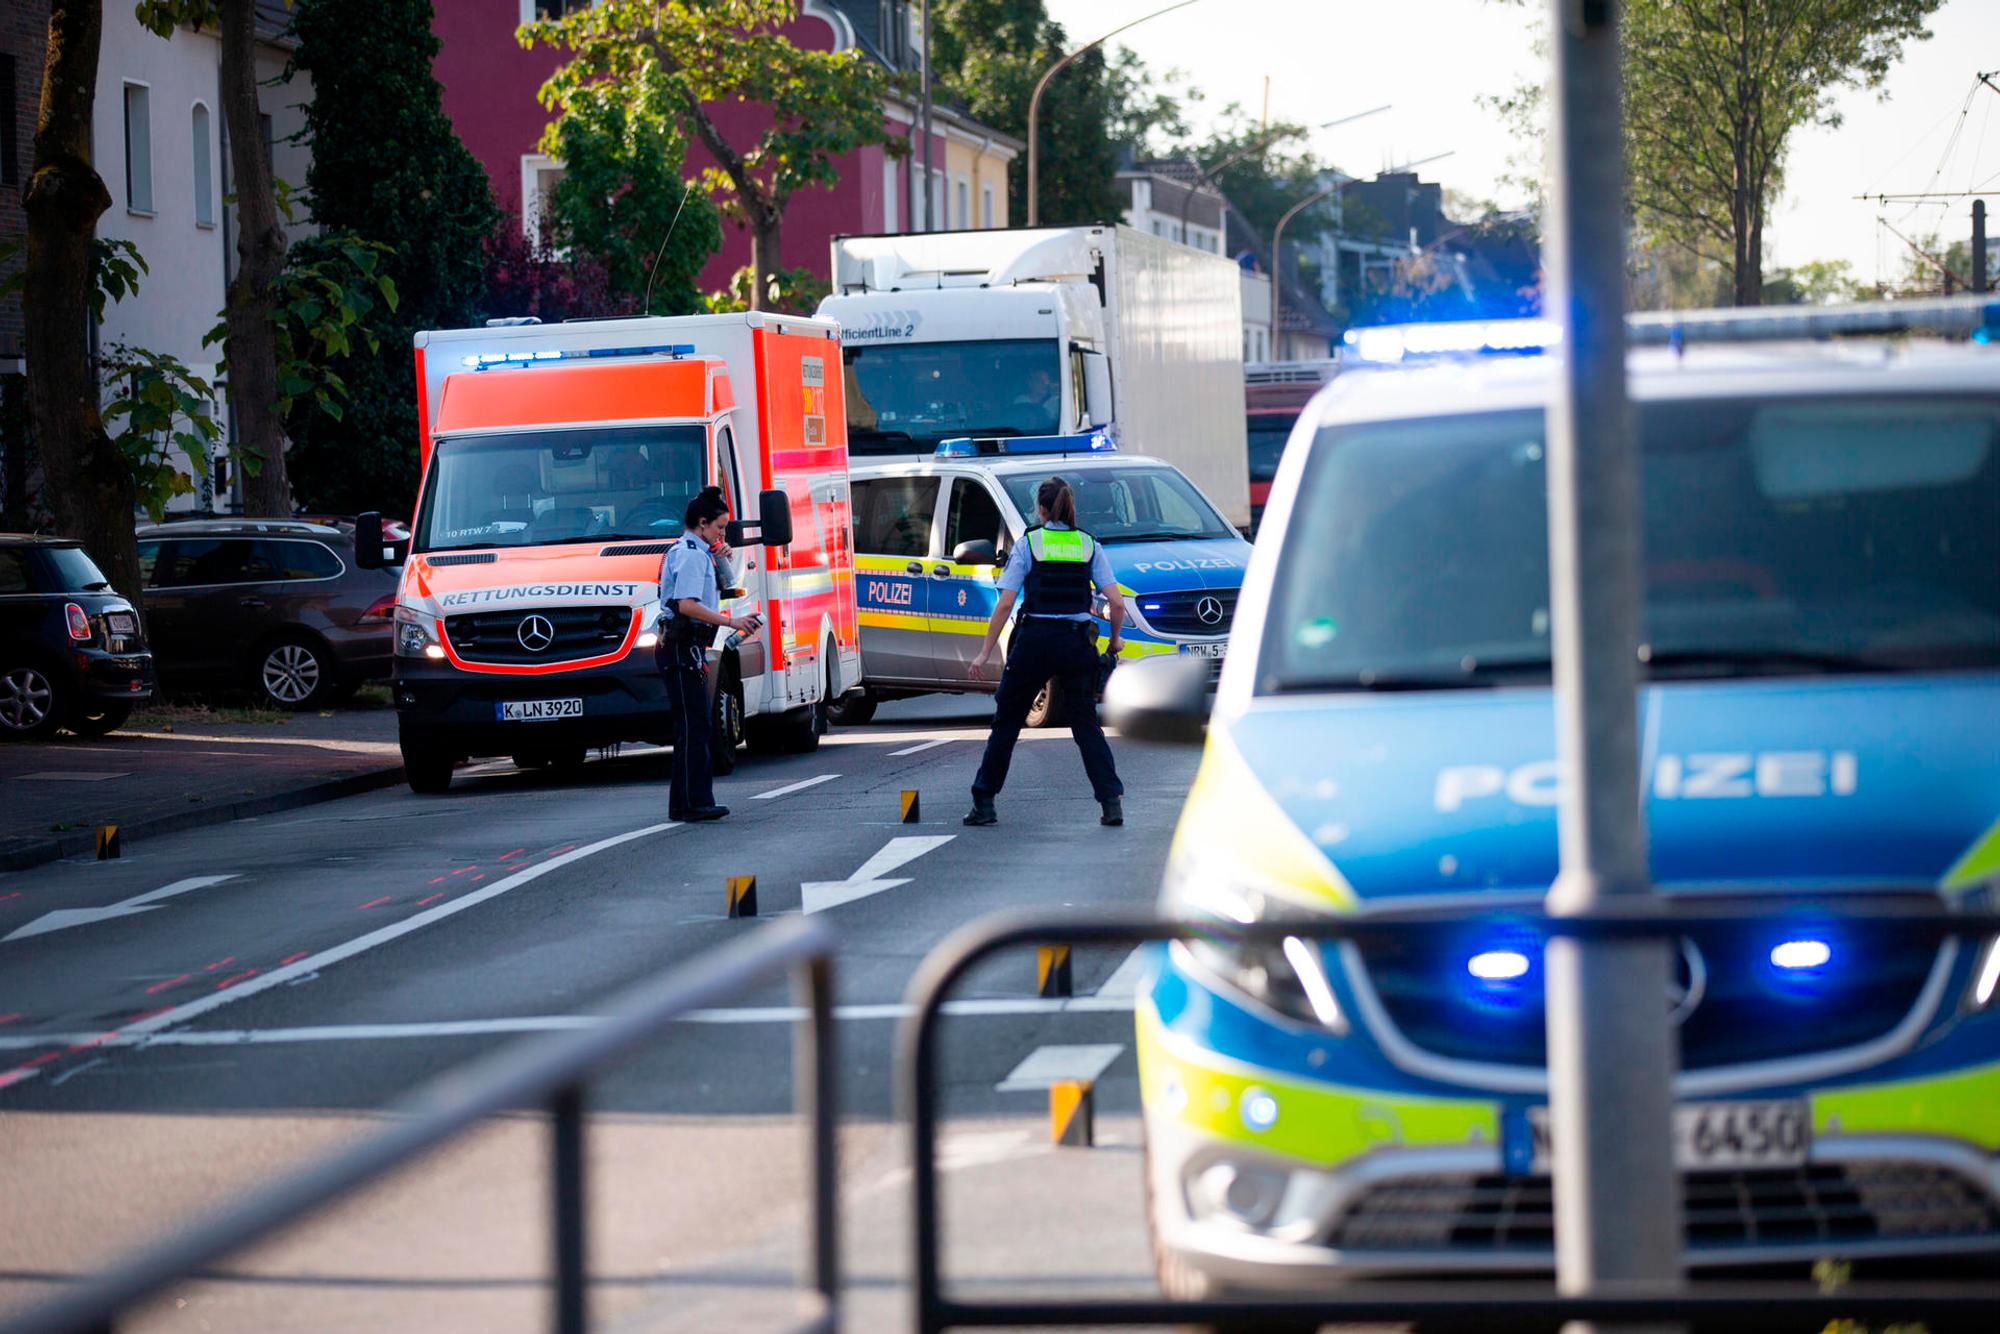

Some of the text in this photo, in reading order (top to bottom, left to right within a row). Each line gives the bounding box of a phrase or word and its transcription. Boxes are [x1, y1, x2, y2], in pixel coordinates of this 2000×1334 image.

[841, 324, 914, 340] fficientLine 2
[460, 526, 483, 537] RTW
[1134, 558, 1237, 573] POLIZEI
[443, 584, 638, 607] RETTUNGSDIENST
[868, 581, 912, 605] POLIZEI
[1187, 645, 1207, 657] NRW
[505, 700, 581, 718] K LN 3920
[1434, 752, 1858, 812] POIZEI
